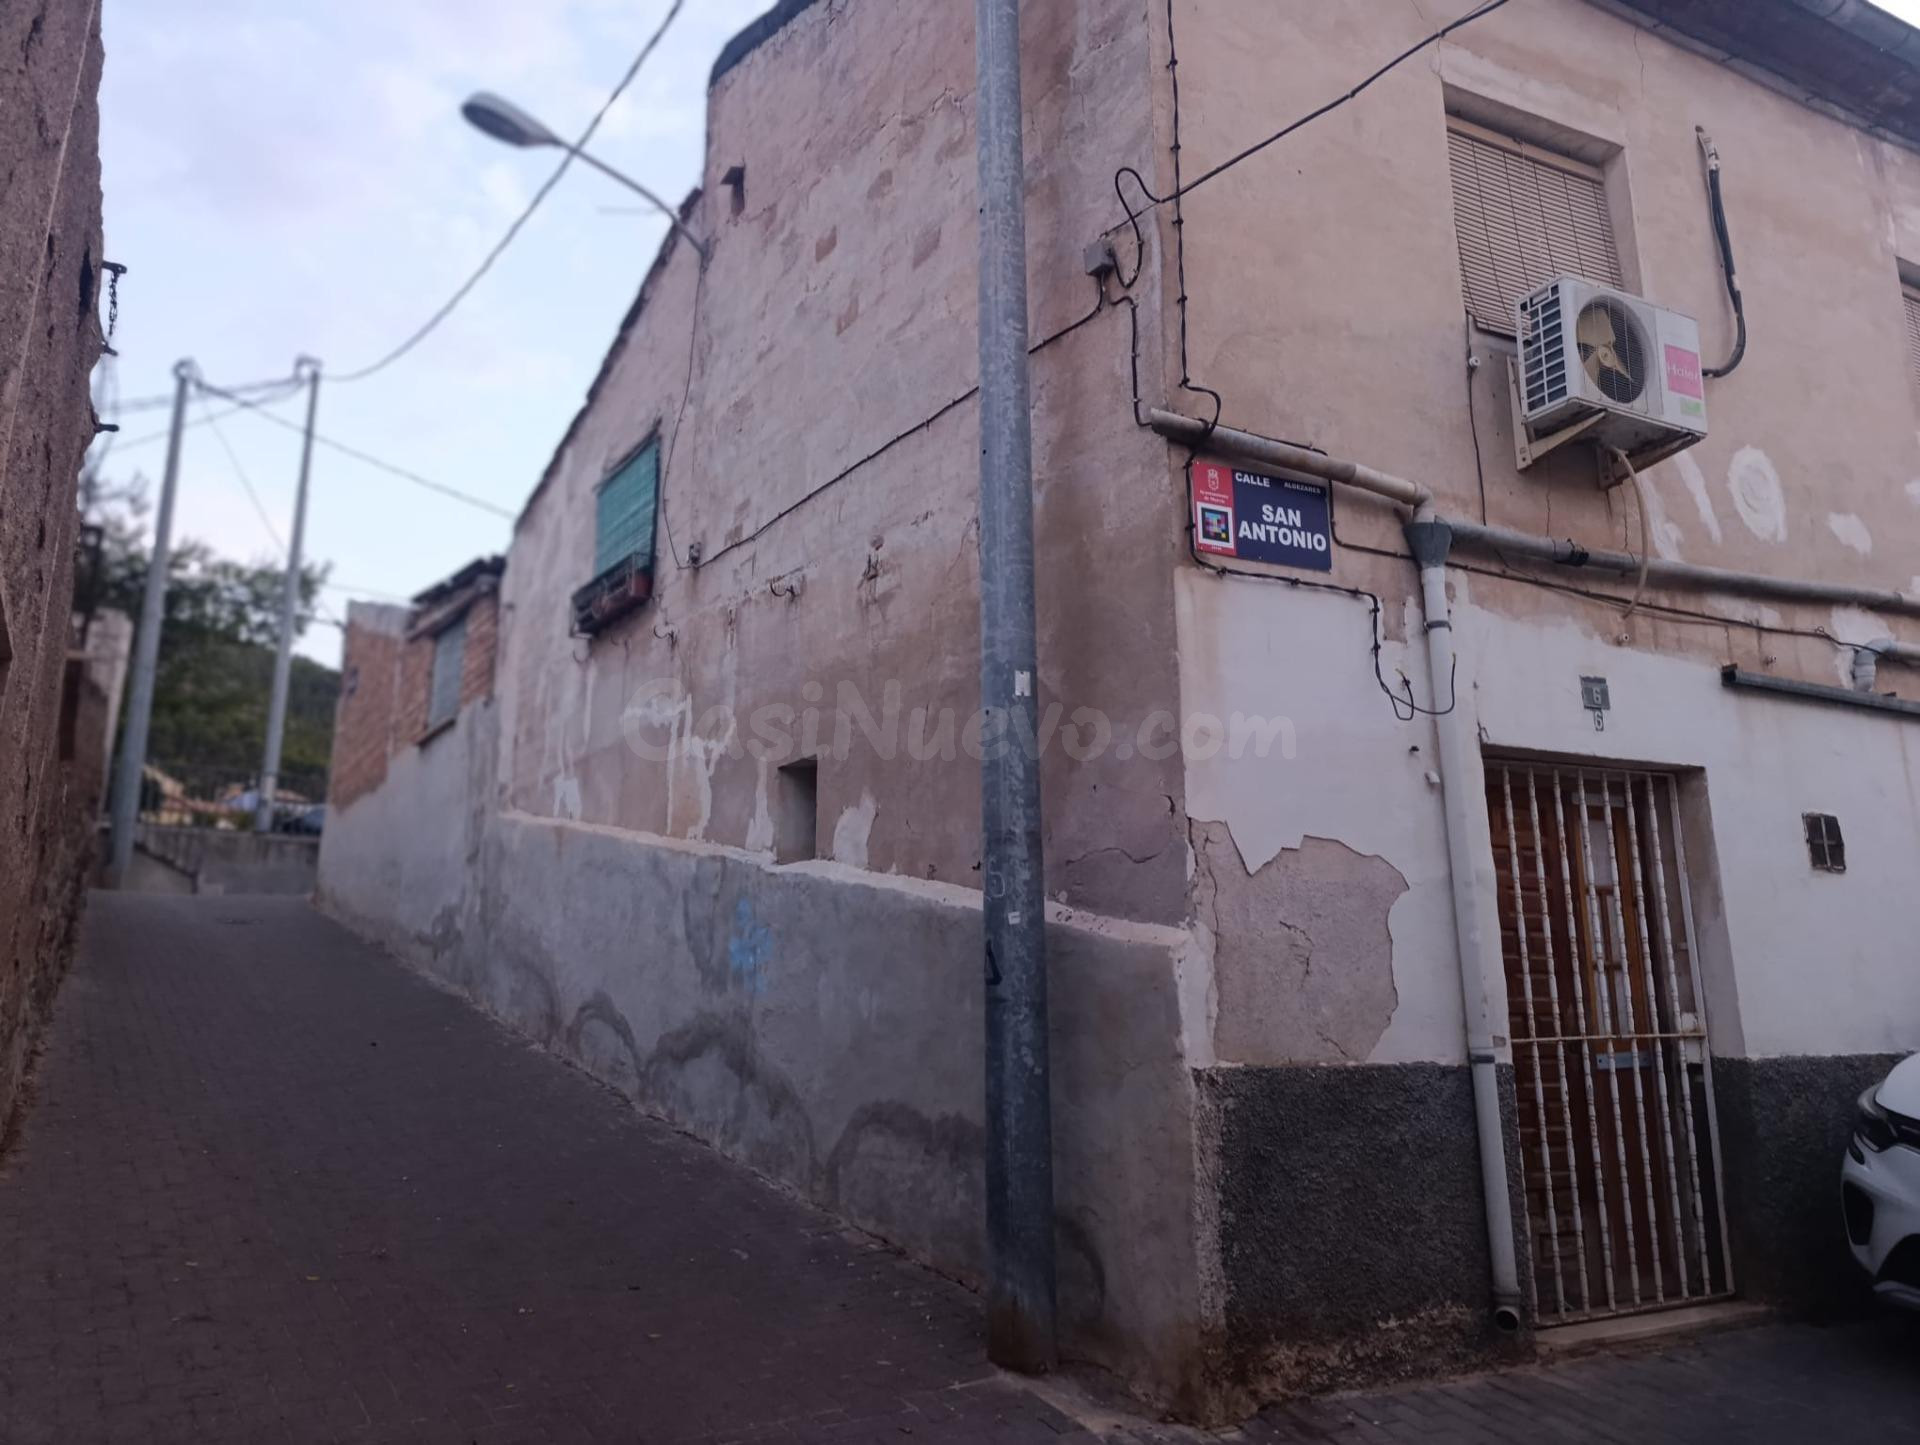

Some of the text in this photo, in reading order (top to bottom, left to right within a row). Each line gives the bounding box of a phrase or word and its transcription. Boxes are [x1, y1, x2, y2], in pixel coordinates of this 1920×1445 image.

[1235, 472, 1271, 488] CALLE
[1261, 504, 1302, 528] SAN
[1238, 520, 1327, 551] ANTONIO
[1592, 687, 1602, 705] 6
[1594, 711, 1603, 730] 6
